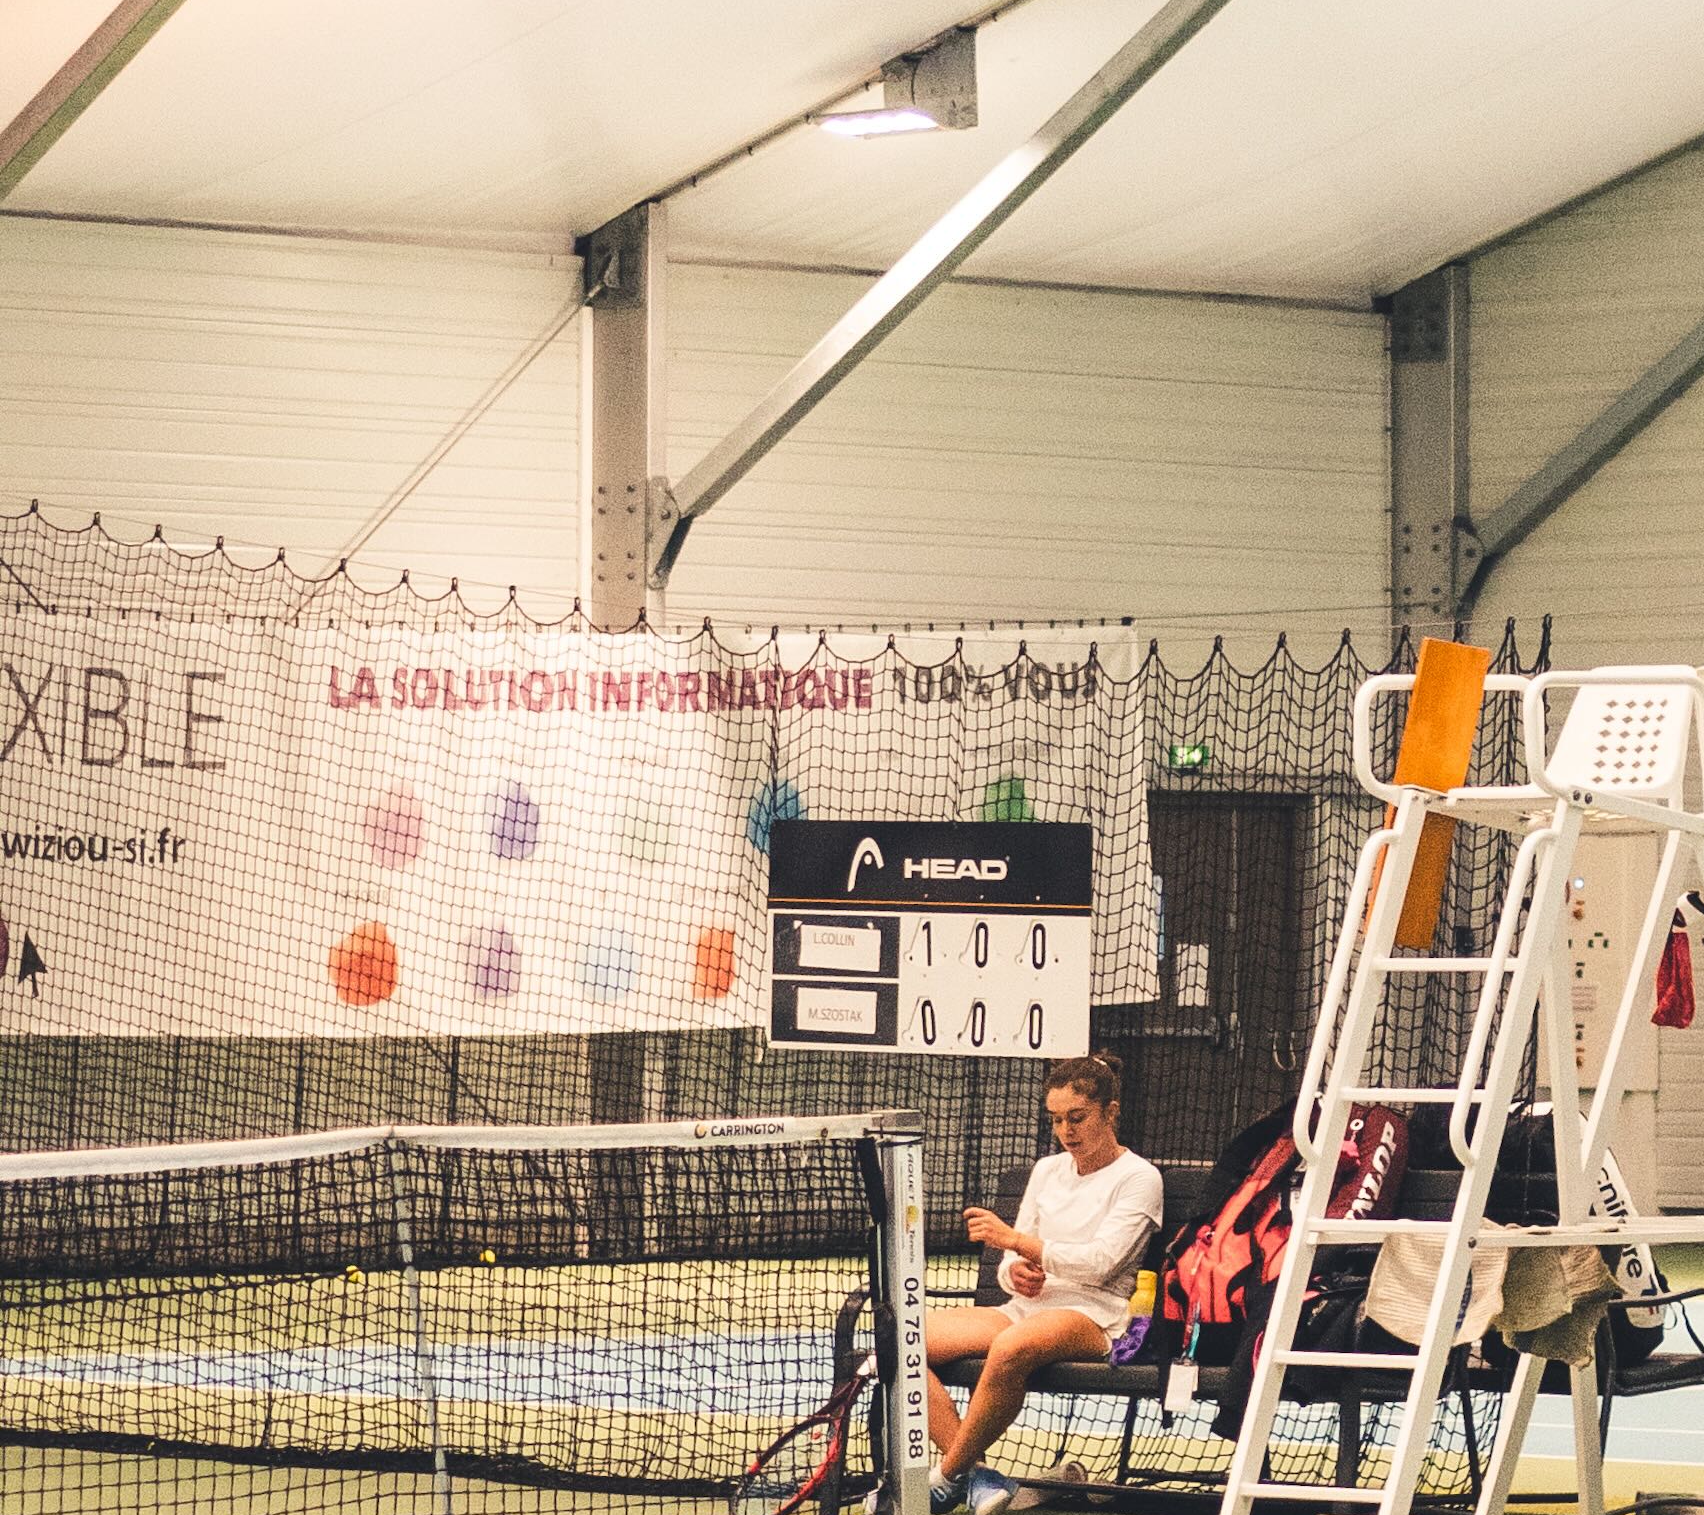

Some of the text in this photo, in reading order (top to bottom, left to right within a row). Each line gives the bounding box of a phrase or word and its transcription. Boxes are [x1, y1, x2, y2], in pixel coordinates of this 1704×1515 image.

[329, 666, 382, 709] LA
[391, 667, 577, 712] SOLUTION
[588, 669, 872, 712] INFORMATIQUE
[1001, 660, 1097, 700] VOUS
[0, 663, 226, 770] XIBLE
[904, 858, 1008, 880] HEAD
[922, 921, 1046, 970] 1 0 0
[921, 1000, 1043, 1050] 0 0 0
[711, 1123, 785, 1137] CARRINGTON
[904, 1277, 924, 1459] 04 75 31 91 88
